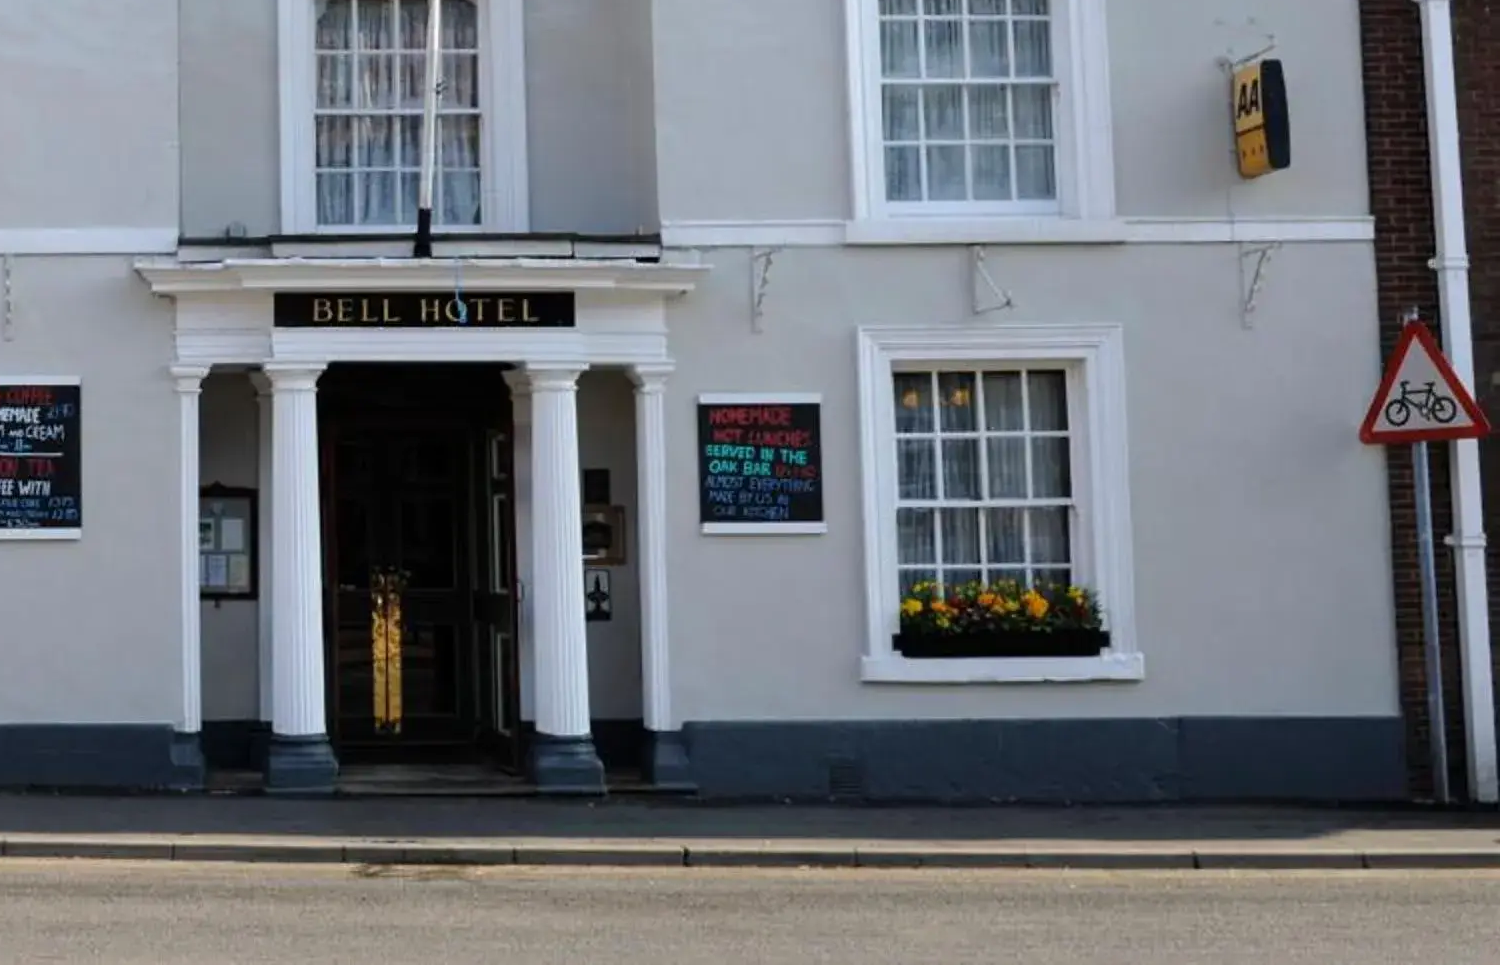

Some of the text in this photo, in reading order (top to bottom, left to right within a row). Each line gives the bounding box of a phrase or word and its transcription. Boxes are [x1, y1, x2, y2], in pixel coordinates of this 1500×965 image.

[1236, 79, 1260, 121] AA
[312, 298, 541, 323] BELL HOTEL
[709, 407, 792, 425] HOMEMADE
[25, 424, 65, 441] CREAM
[712, 429, 811, 447] HOT LUNCHES
[706, 444, 807, 465] SERVED IN THE
[709, 460, 738, 474] OAK
[744, 461, 771, 475] BAR
[18, 479, 51, 496] WITH
[705, 475, 815, 493] ALMOST EVERYTHING
[709, 491, 736, 504] MADE
[755, 492, 773, 505] US
